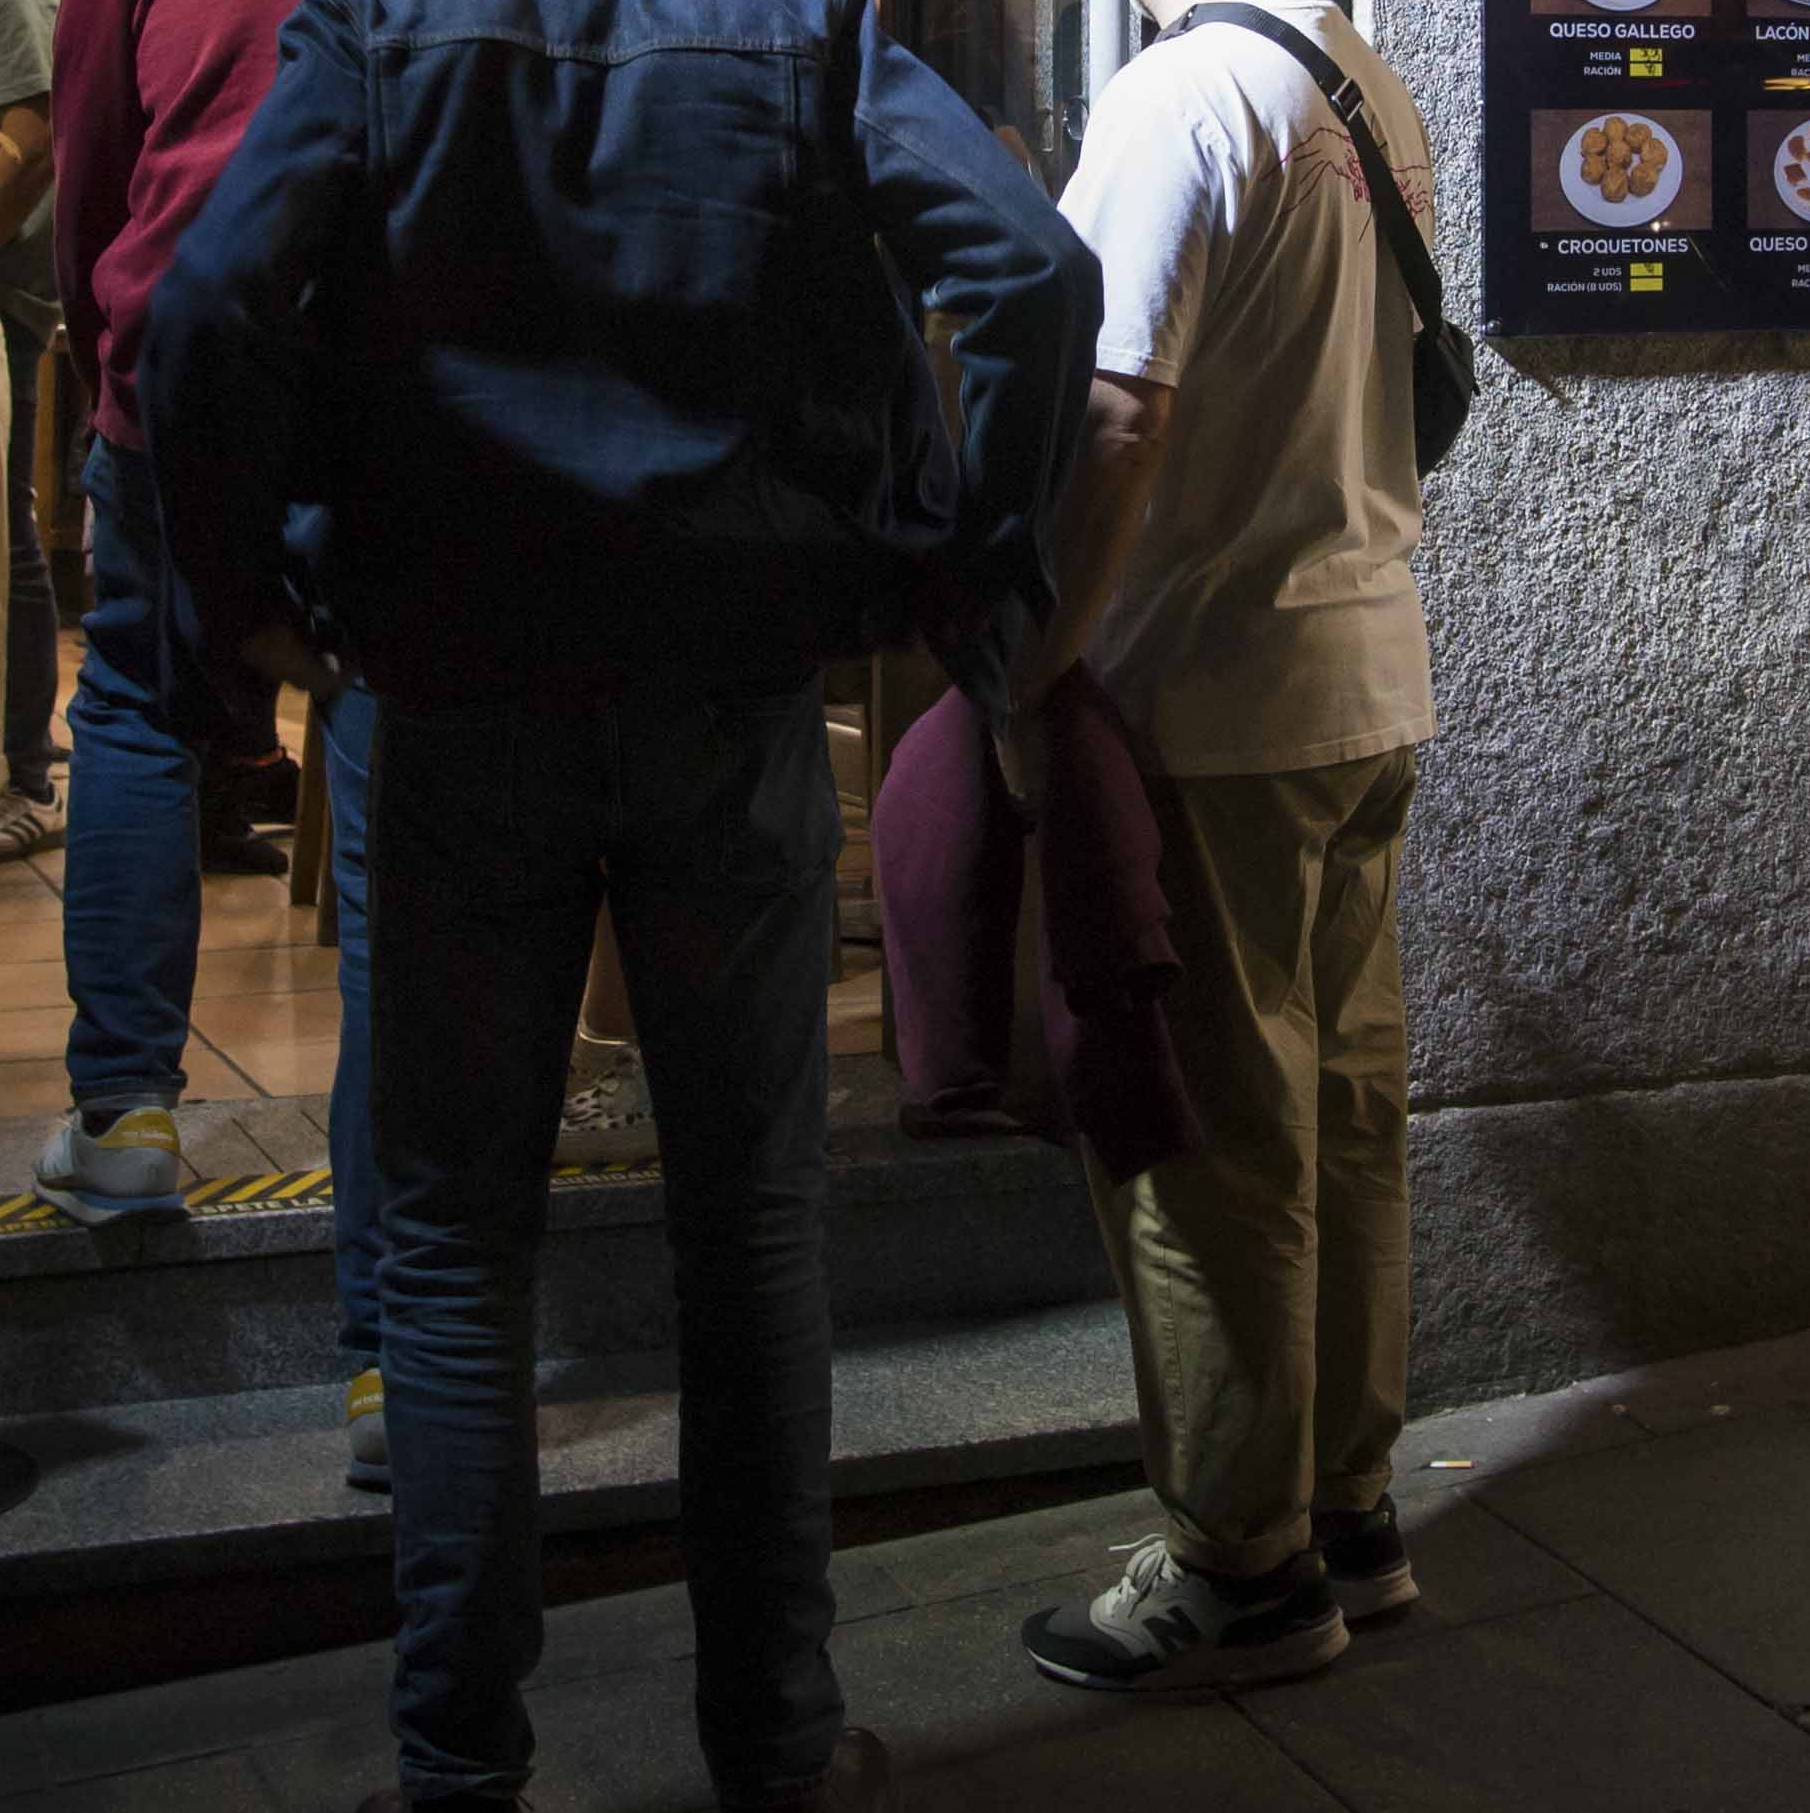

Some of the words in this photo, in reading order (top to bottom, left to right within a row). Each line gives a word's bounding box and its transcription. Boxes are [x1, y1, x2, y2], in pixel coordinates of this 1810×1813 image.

[1549, 22, 1612, 39] QUESO
[1614, 23, 1695, 39] GALLEGO
[1755, 22, 1809, 41] LACÓN
[1590, 50, 1622, 61] MEDIA
[1583, 63, 1622, 76] RACIÓN
[1557, 237, 1688, 254] CROQUETONES
[1750, 236, 1808, 252] QUESO
[1593, 267, 1600, 277] 2
[1602, 266, 1622, 277] UDS
